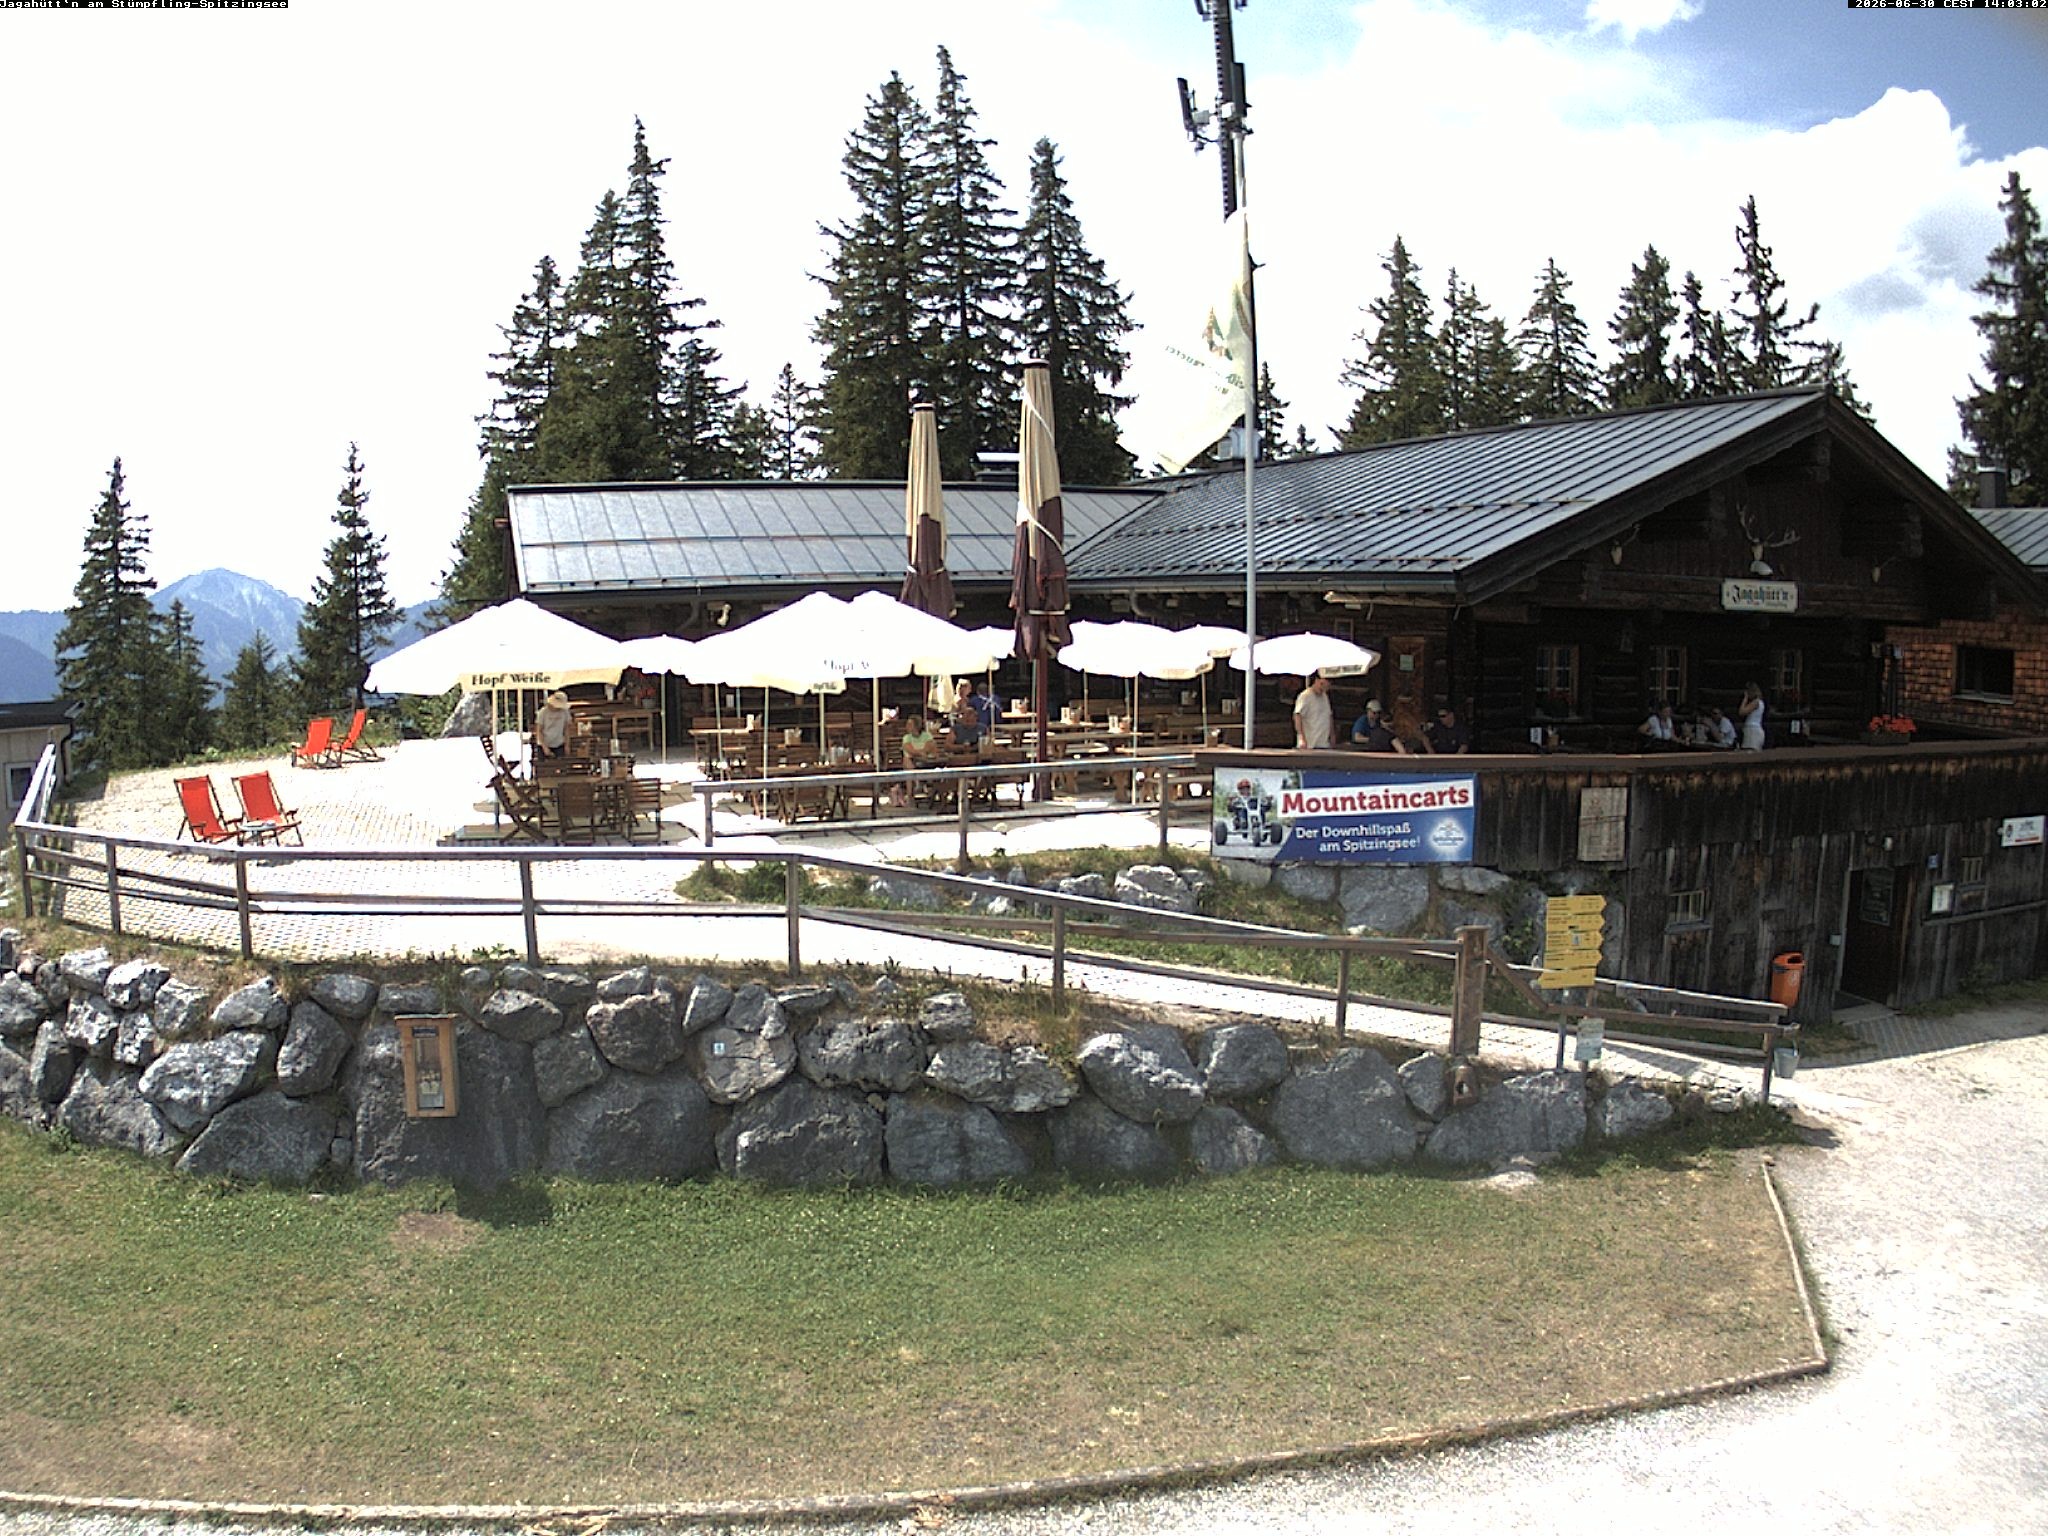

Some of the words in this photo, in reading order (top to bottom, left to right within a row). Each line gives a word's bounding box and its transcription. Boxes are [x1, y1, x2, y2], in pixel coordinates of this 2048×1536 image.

[472, 674, 507, 688] Hopf
[510, 672, 551, 683] Weiße
[1281, 786, 1469, 814] Mountaincarts
[1295, 827, 1318, 838] Der
[1322, 822, 1411, 838] Downhillspaß
[1319, 841, 1340, 852] am
